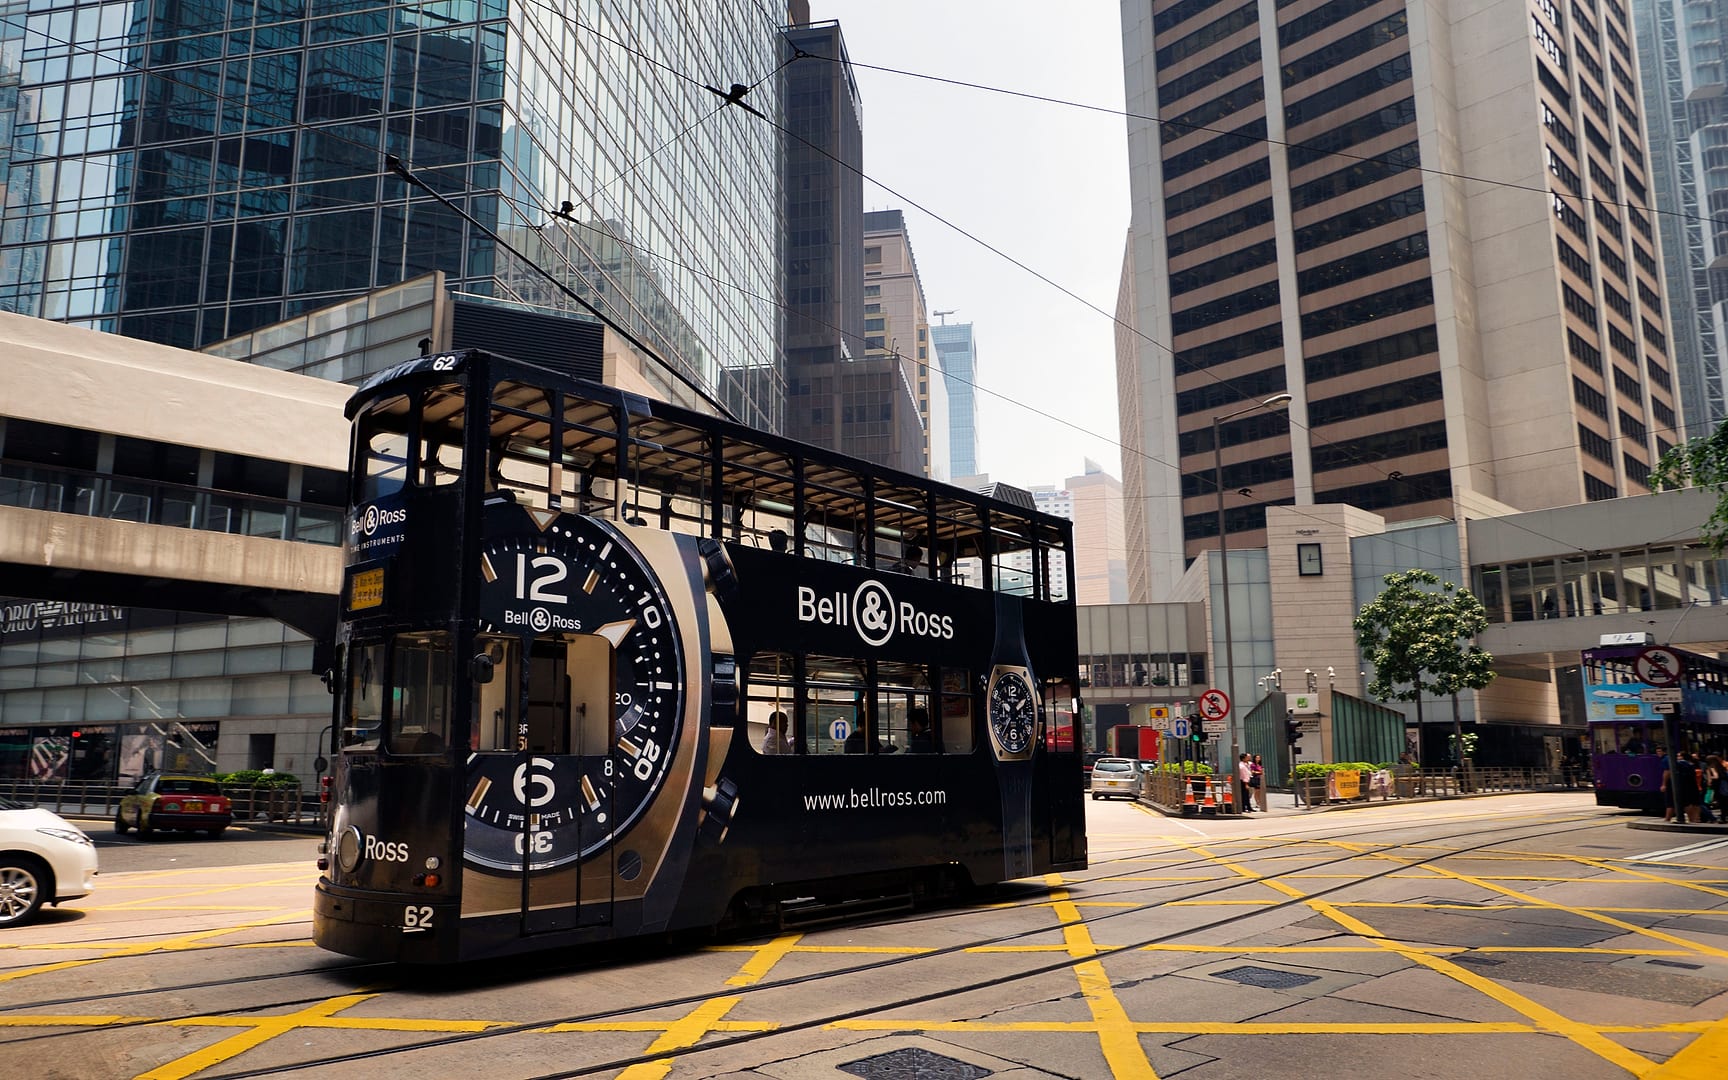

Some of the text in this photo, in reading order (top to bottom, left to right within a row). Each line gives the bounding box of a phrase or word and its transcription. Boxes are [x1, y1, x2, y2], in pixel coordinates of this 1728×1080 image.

[432, 356, 455, 371] 62
[351, 516, 364, 536] Bell
[379, 509, 406, 526] Ross
[361, 534, 405, 549] INSTRUMENTS
[515, 553, 568, 604] 12
[504, 610, 529, 625] Bell
[552, 615, 582, 630] Ross
[637, 590, 661, 630] 10
[797, 586, 848, 626] Bell
[900, 601, 954, 639] Ross
[1008, 686, 1017, 697] 12
[1010, 729, 1017, 740] 6
[634, 738, 661, 781] 20
[513, 757, 556, 807] 6
[803, 787, 947, 811] www.bellross.com
[365, 835, 409, 862] Ross
[404, 905, 434, 928] 62
